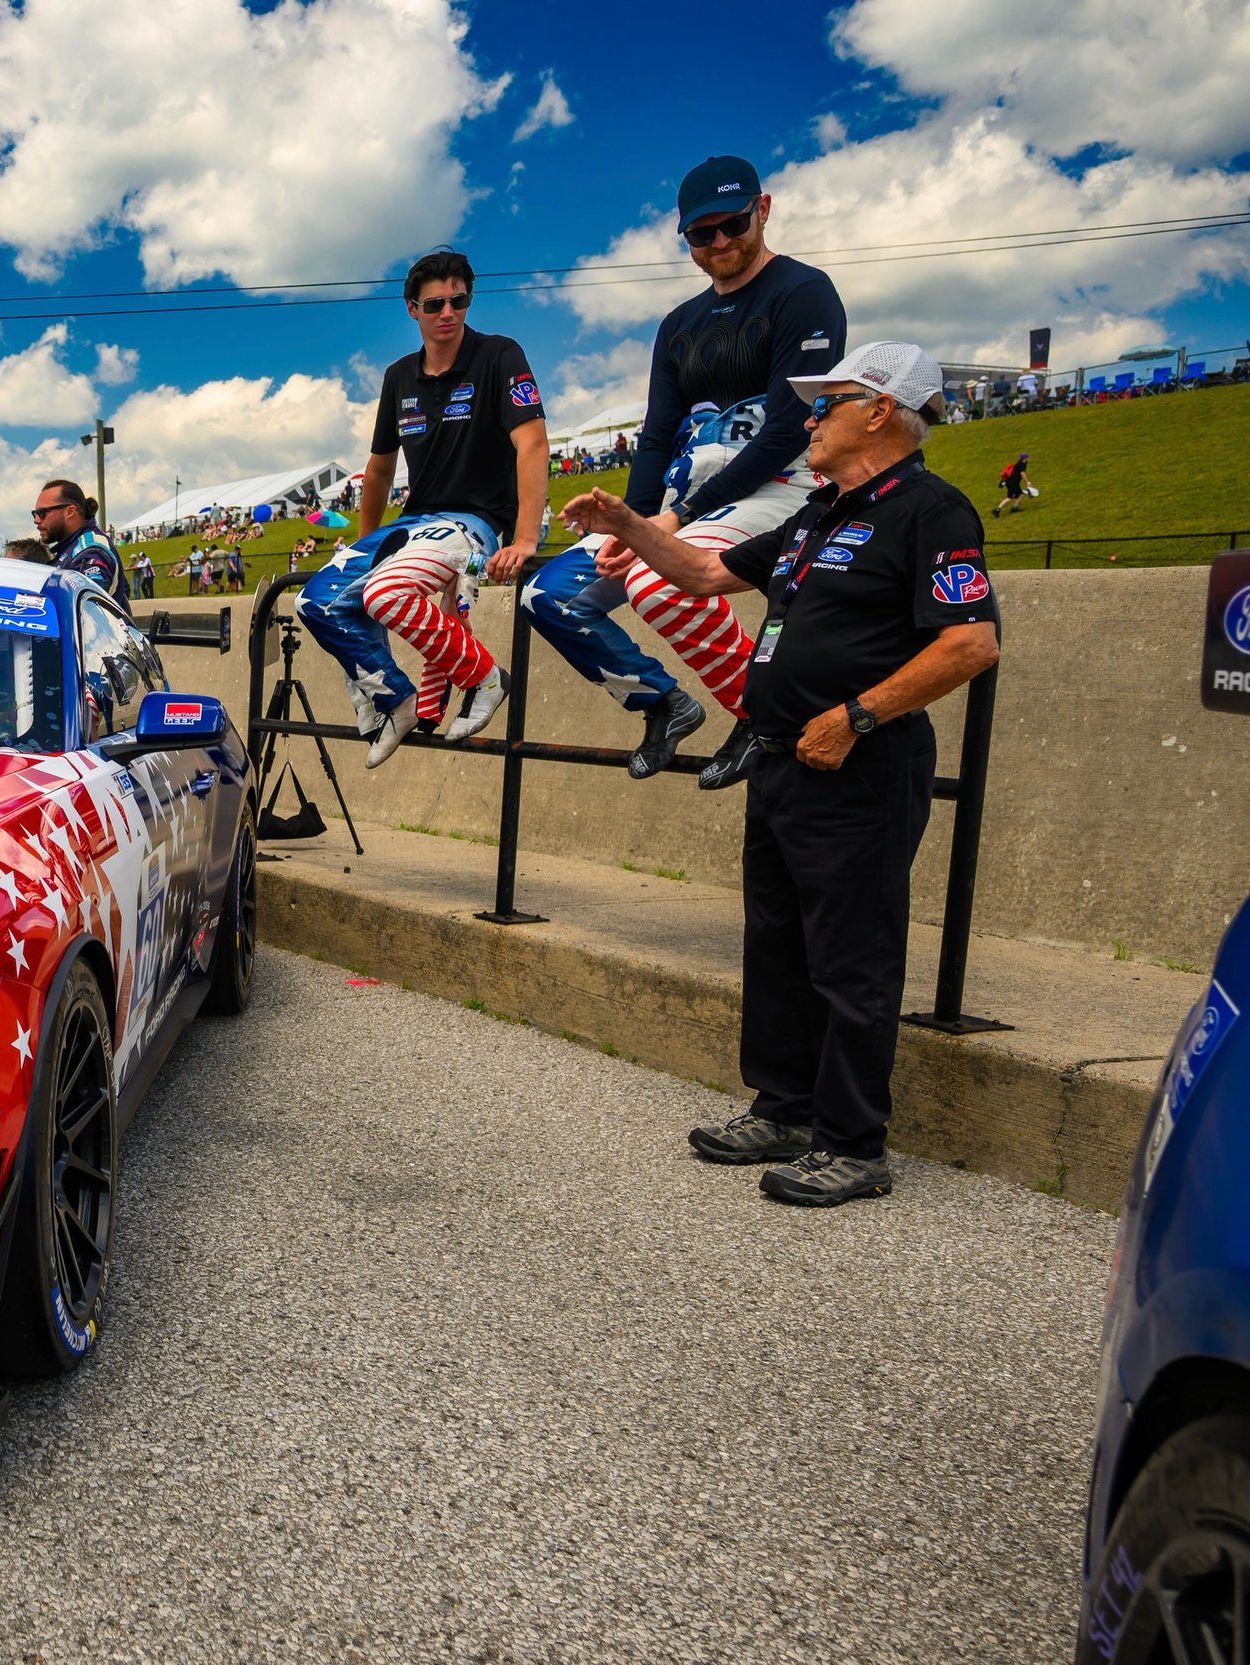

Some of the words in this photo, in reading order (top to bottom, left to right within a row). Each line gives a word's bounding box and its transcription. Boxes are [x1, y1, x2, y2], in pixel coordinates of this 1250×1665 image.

[718, 182, 741, 193] KOHR
[510, 382, 534, 405] VP
[877, 479, 900, 496] IMSA
[821, 548, 847, 560] Ford
[932, 563, 975, 604] VP
[963, 582, 988, 598] Racing
[55, 1295, 86, 1352] MICHELIN
